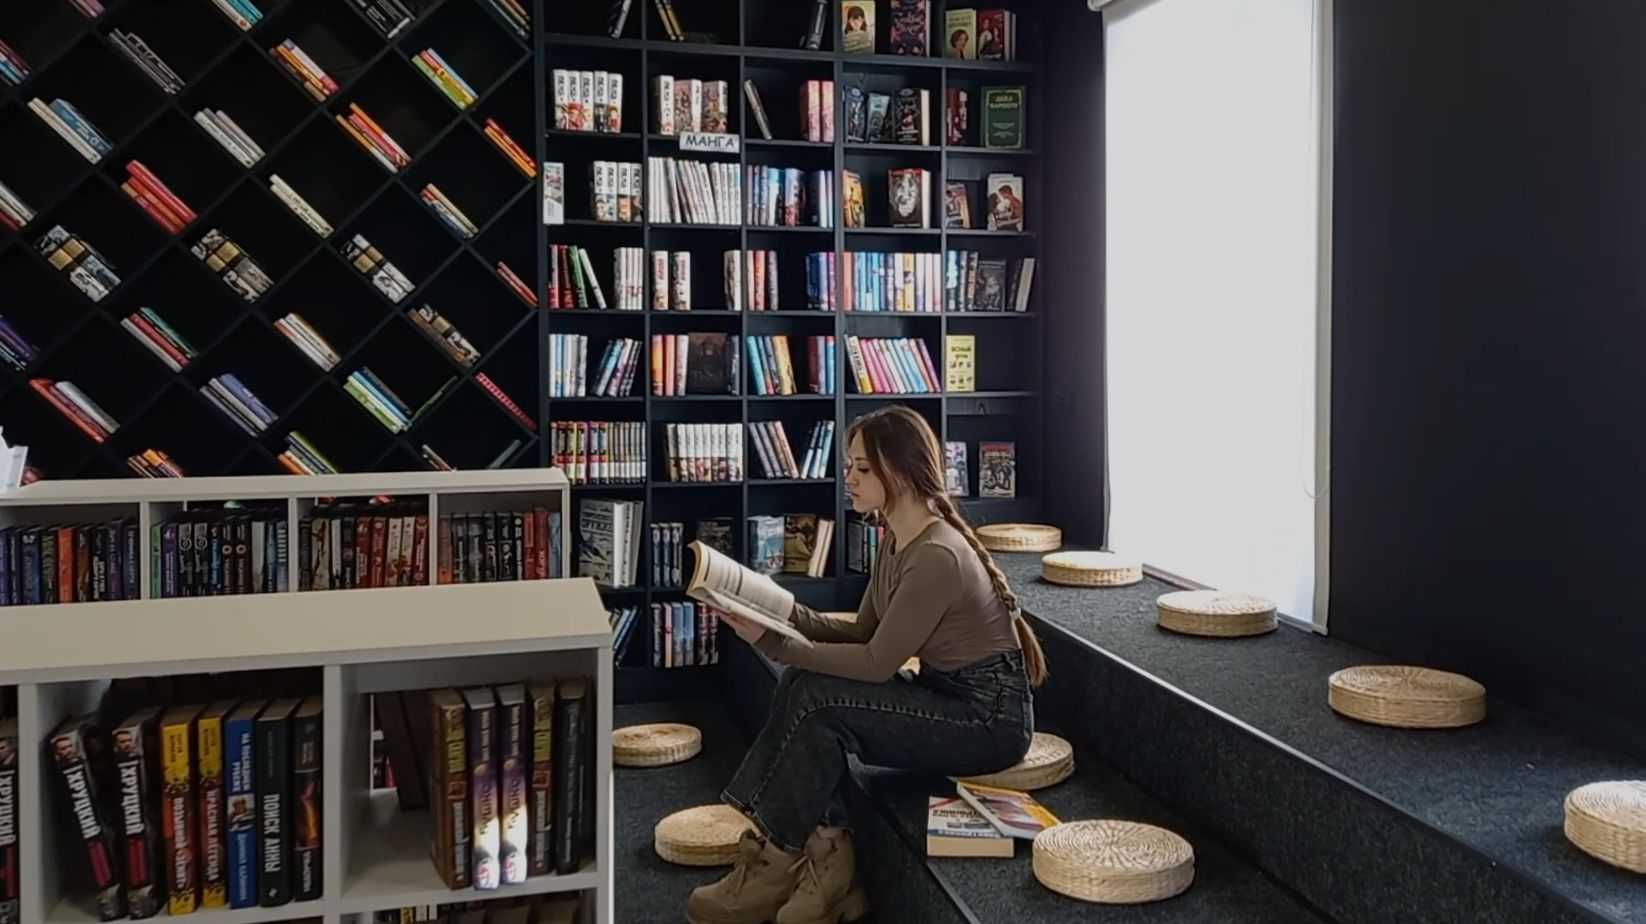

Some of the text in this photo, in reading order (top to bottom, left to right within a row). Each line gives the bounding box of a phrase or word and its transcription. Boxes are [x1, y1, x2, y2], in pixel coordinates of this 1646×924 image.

[685, 135, 736, 148] МАНГА
[241, 733, 250, 744] НА
[65, 771, 100, 839] ХРУЦКИЙ
[120, 767, 145, 835] ХРУЦКИЙ
[173, 797, 187, 848] ПОЗЫВНОЙ
[263, 793, 281, 834] ПОИСК
[205, 790, 218, 881] КРАСНАЯ ЛЕГЕНДА
[264, 838, 281, 873] АННЫ
